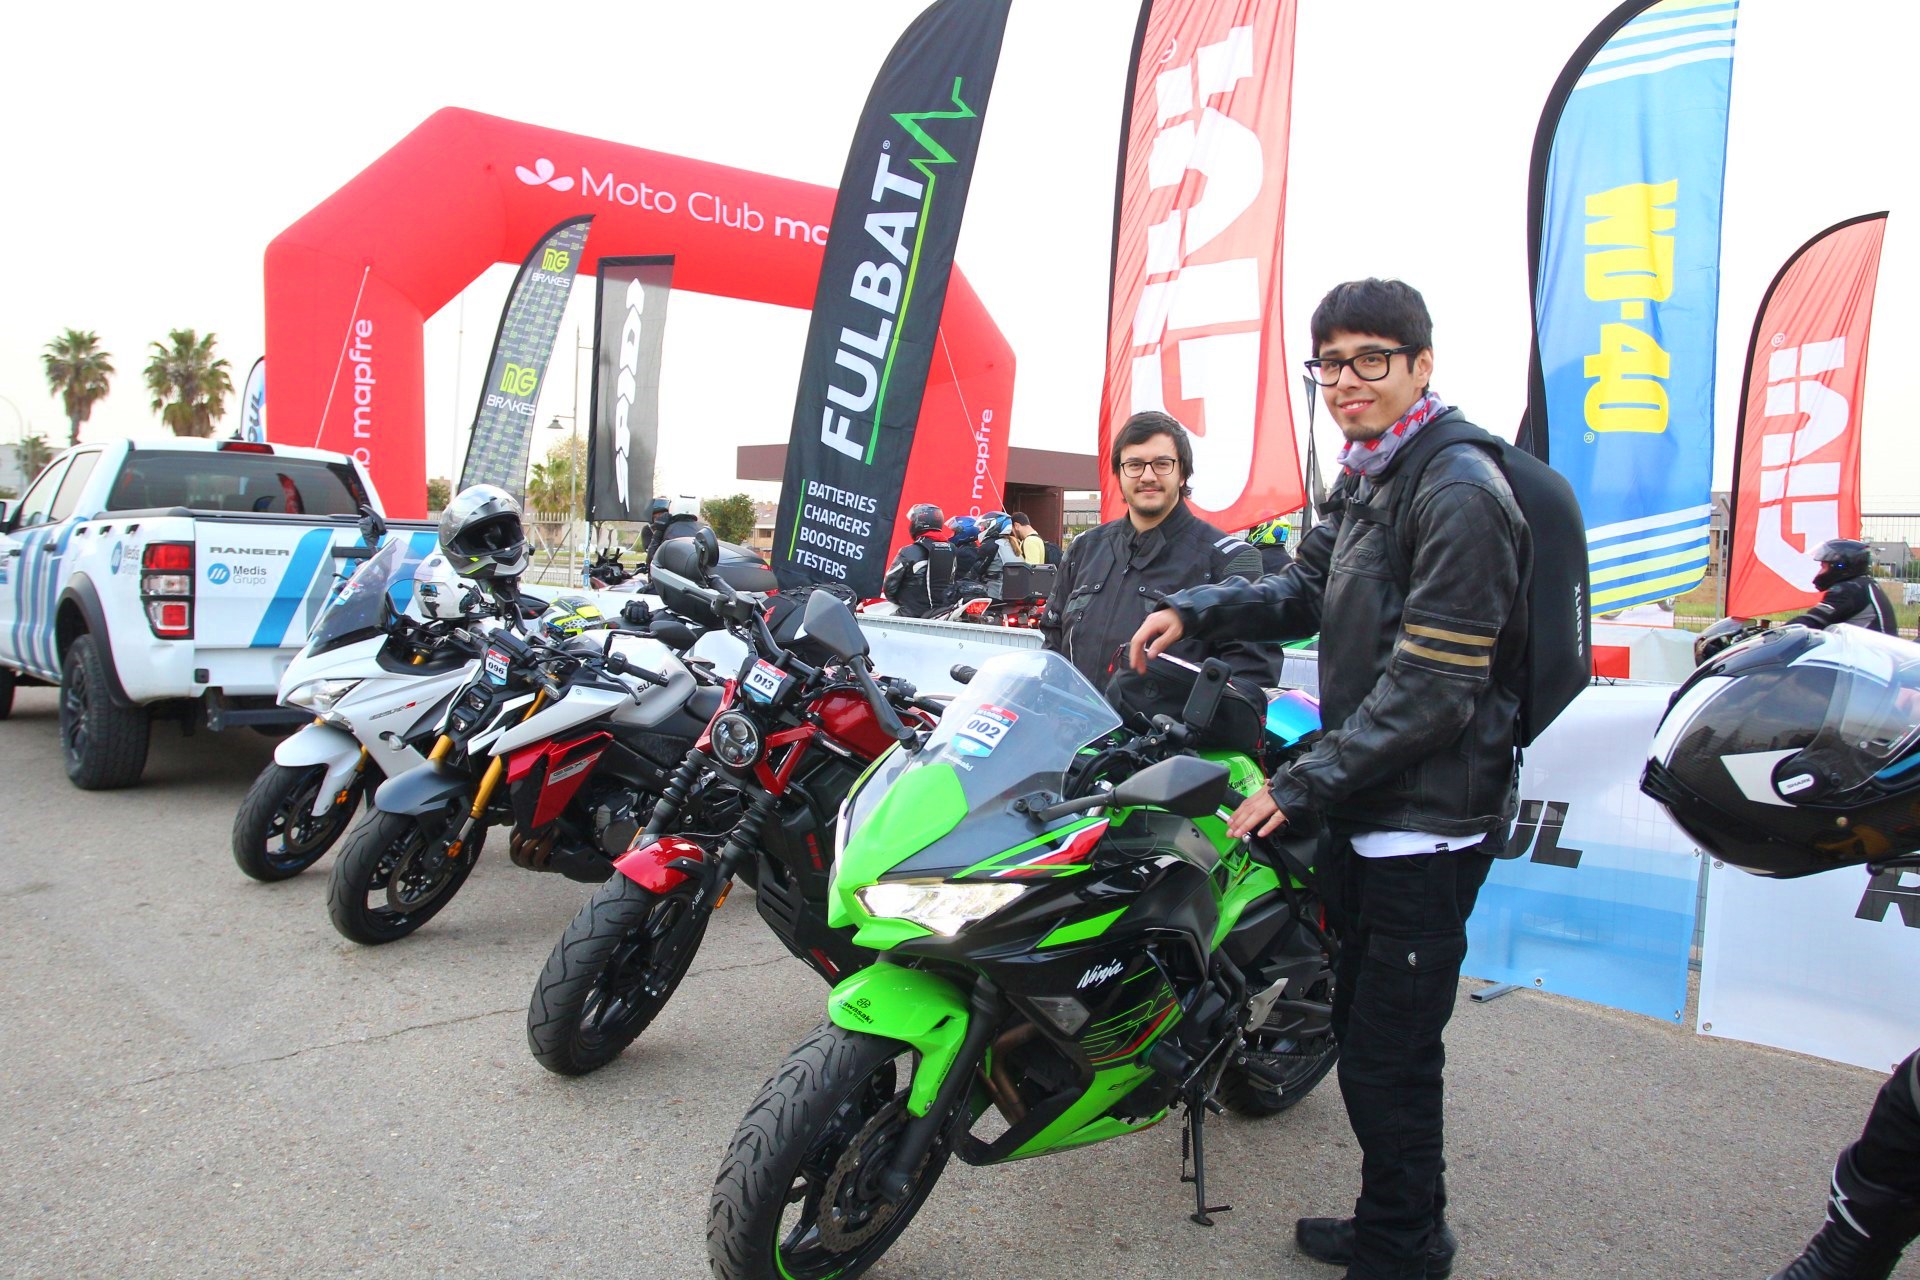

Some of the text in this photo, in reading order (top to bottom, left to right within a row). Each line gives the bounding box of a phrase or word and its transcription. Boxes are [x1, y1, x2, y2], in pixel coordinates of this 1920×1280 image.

[581, 166, 677, 214] Moto
[687, 191, 764, 232] Club
[531, 272, 571, 288] BRAKES
[349, 319, 376, 438] mapfre
[486, 394, 536, 417] BRAKES
[972, 408, 993, 499] mapfre
[807, 480, 877, 514] BATTERIES
[803, 503, 872, 537] CHARGERS
[209, 546, 290, 556] RANGER
[800, 526, 865, 560] BOOSTERS
[233, 565, 267, 576] Medis
[796, 548, 847, 580] TESTERS
[232, 576, 267, 586] Grupo
[637, 668, 668, 693] SUKI
[753, 673, 775, 690] 013
[966, 719, 1001, 739] 002
[1786, 777, 1811, 789] SHARK
[1076, 958, 1124, 989] Ninja
[838, 999, 875, 1025] Kawasaki
